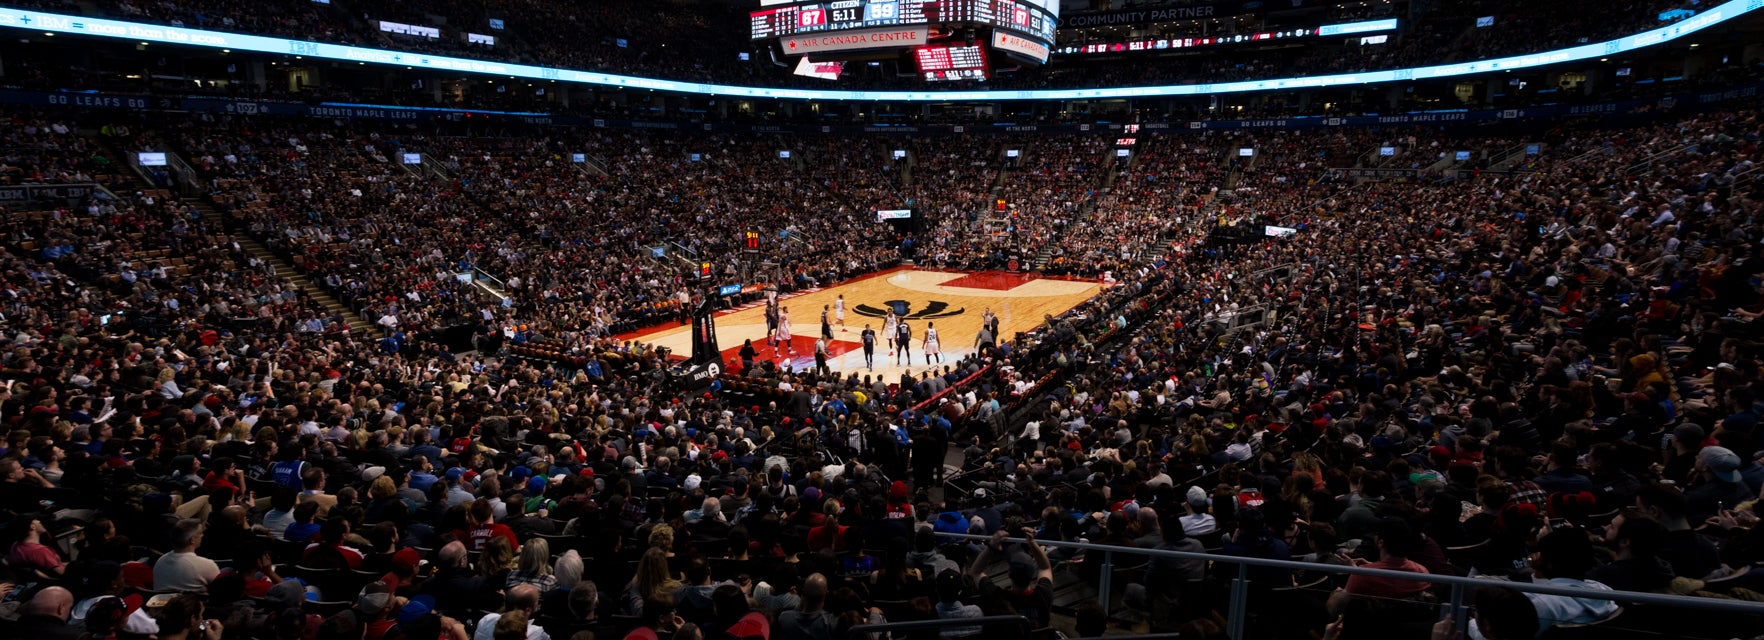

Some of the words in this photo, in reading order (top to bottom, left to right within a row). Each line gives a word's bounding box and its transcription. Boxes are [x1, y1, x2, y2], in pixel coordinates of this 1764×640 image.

[831, 0, 860, 9] CITIZEN
[872, 3, 892, 18] 59
[803, 11, 820, 25] 67
[833, 9, 856, 21] 5:11
[1016, 10, 1027, 25] 67
[1070, 12, 1146, 27] COMMUNITY
[1151, 6, 1214, 20] PARTNER
[36, 15, 69, 31] IBM
[88, 23, 127, 36] more
[130, 25, 164, 40] than
[166, 28, 187, 42] the
[823, 35, 866, 46] CANADA
[871, 31, 916, 42] CENTRE
[289, 41, 320, 55] IBM
[49, 95, 67, 104] GO
[76, 97, 121, 107] LEAFS
[129, 99, 145, 108] GO
[238, 103, 257, 114] 107
[310, 107, 352, 117] TORONTO
[356, 110, 385, 118] MAPLE
[391, 112, 417, 120] LEAFS
[1379, 115, 1409, 123] TORONTO
[694, 370, 708, 381] BMO
